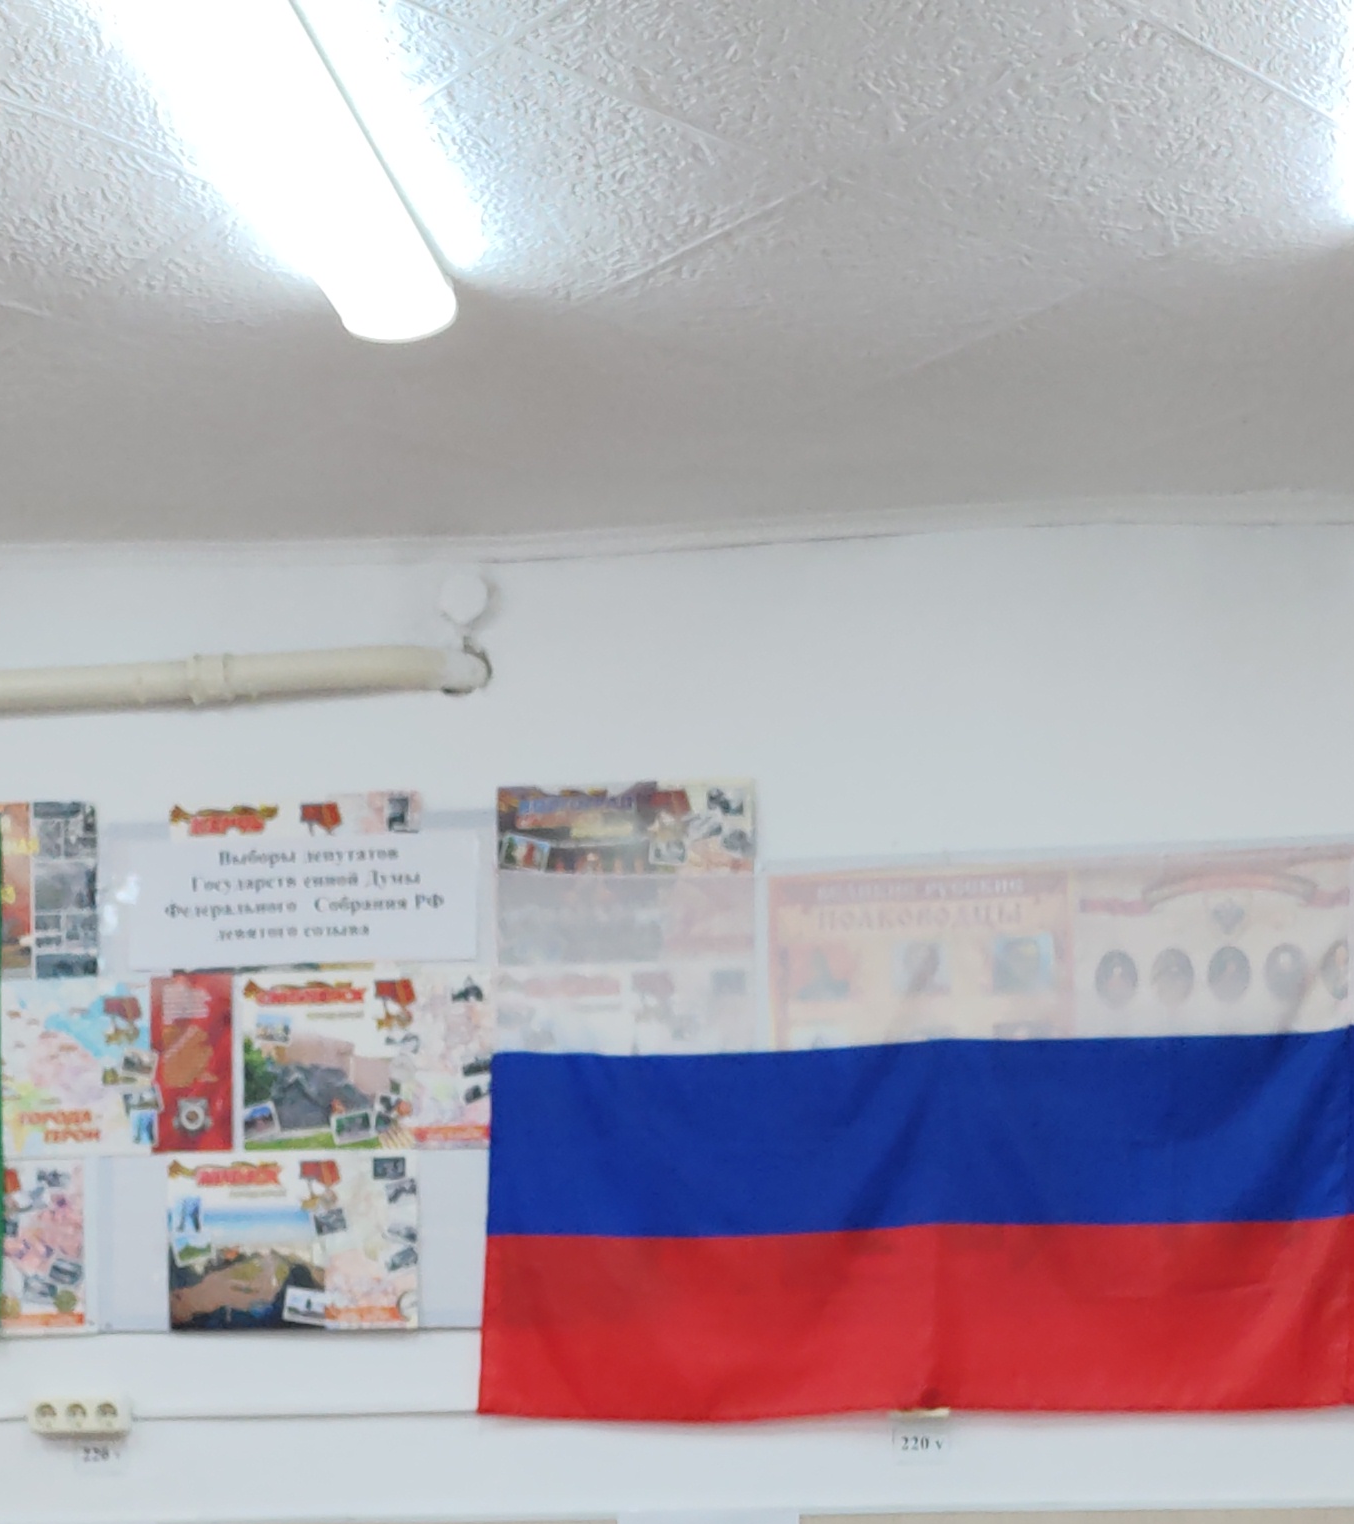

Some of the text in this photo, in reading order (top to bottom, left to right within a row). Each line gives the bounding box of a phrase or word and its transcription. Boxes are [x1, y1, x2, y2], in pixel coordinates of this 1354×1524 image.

[218, 847, 400, 868] Выборы депутатов
[365, 869, 422, 888] Думы
[164, 893, 445, 921] Федерального Собрания РФ
[900, 1435, 930, 1451] 220
